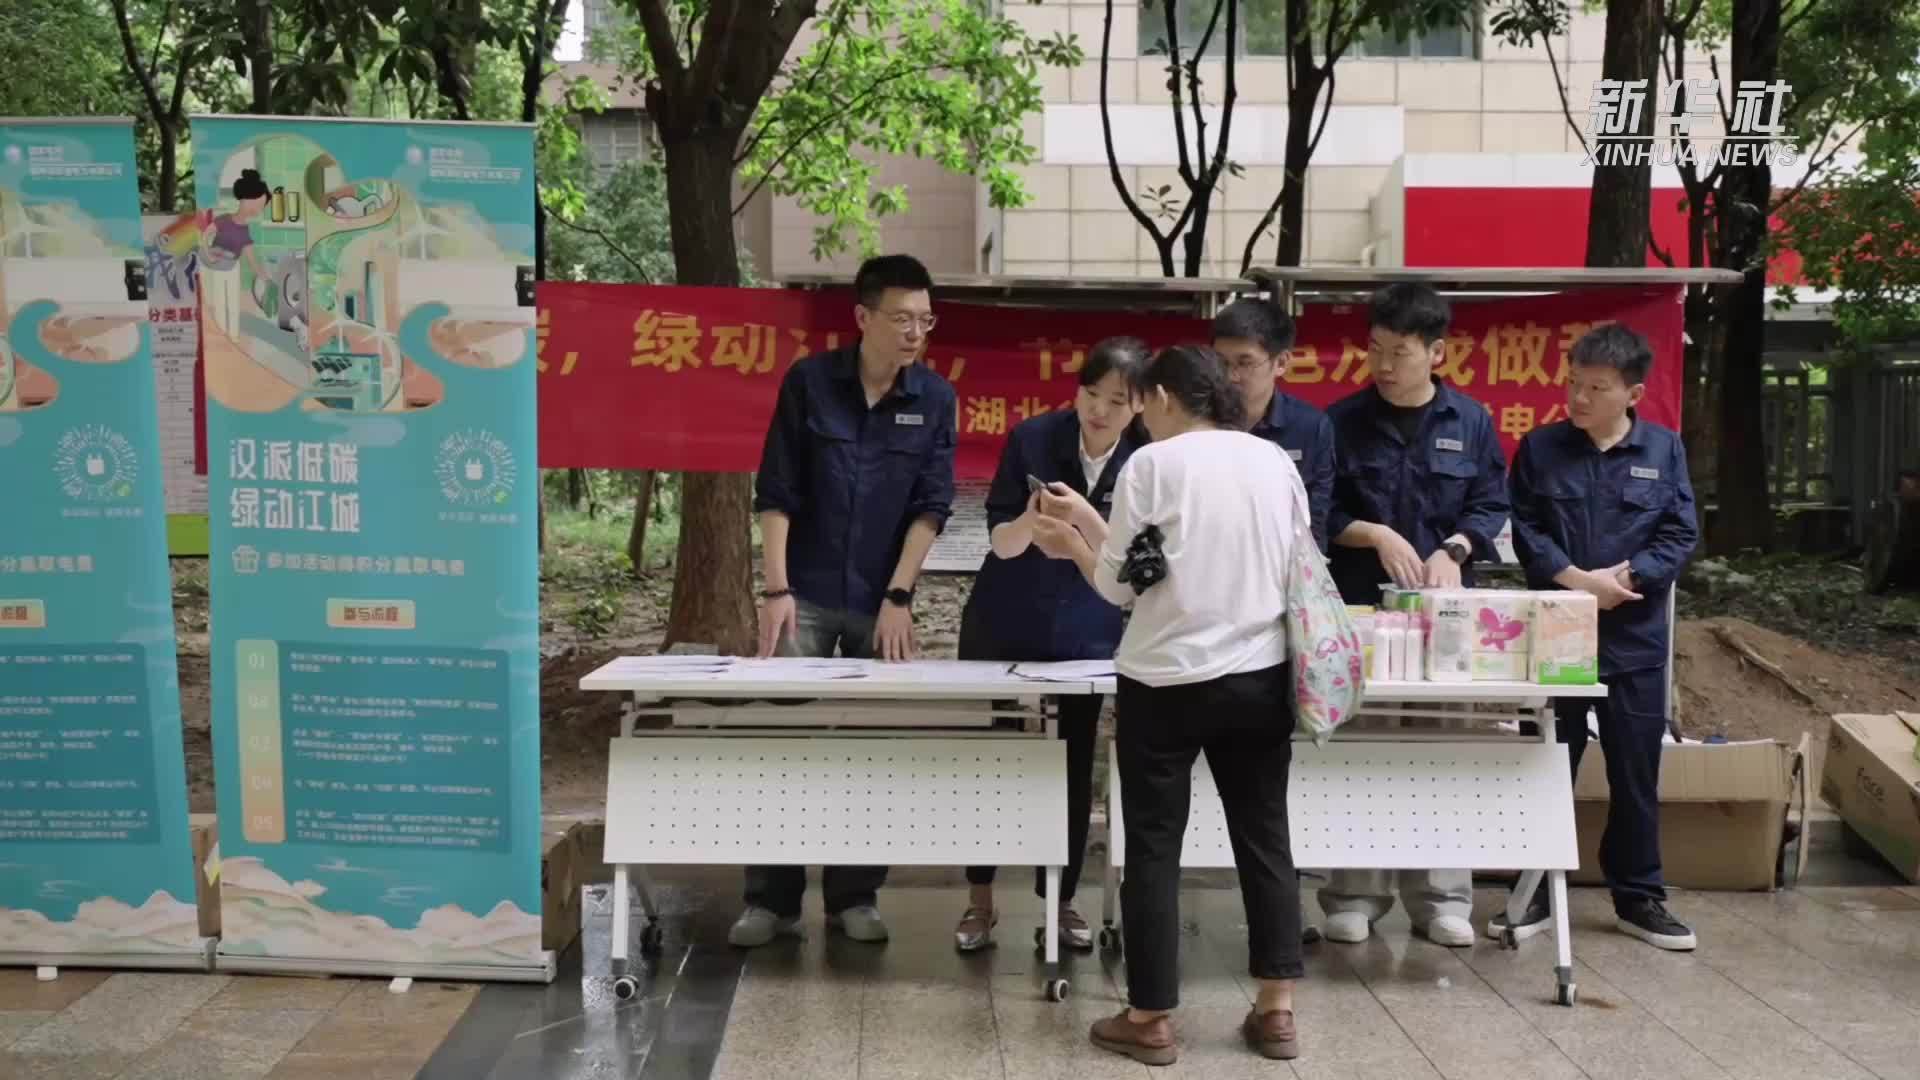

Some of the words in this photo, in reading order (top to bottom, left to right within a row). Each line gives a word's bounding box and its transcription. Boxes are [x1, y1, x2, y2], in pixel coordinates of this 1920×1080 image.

[229, 438, 360, 484] 汉派低碳
[229, 487, 361, 533] 绿动江城
